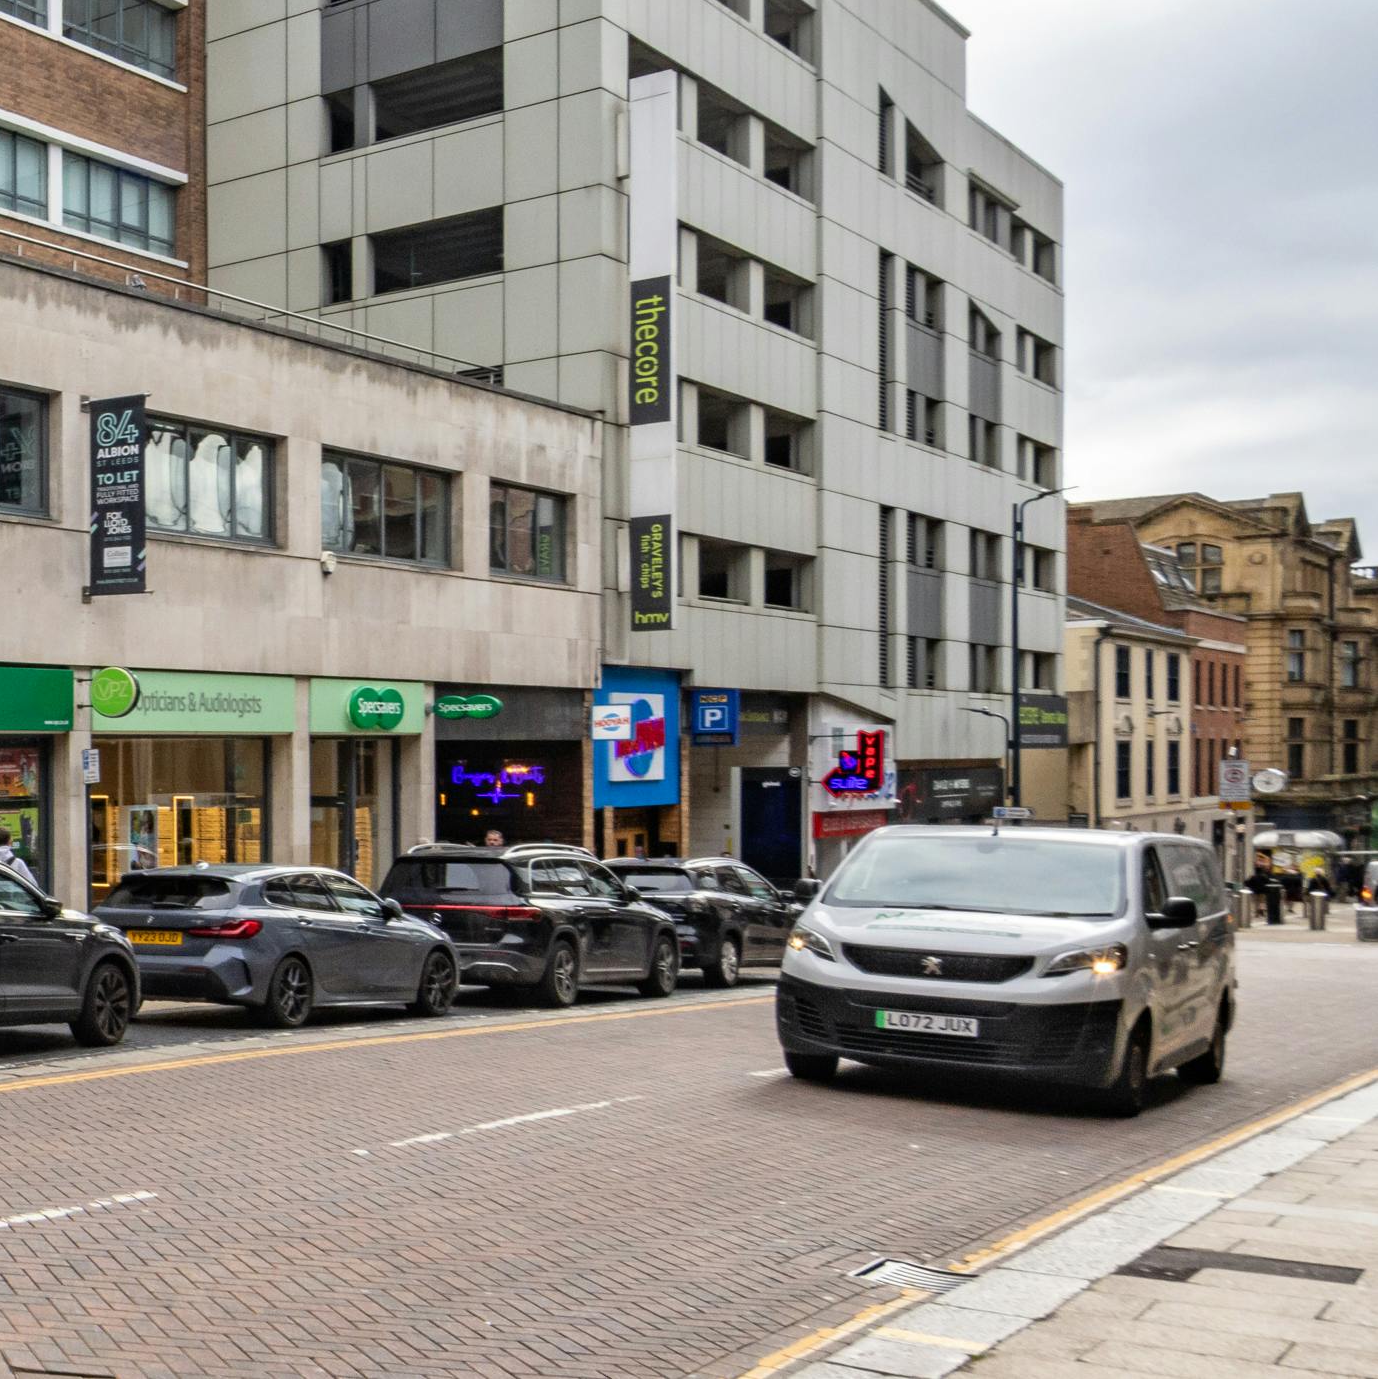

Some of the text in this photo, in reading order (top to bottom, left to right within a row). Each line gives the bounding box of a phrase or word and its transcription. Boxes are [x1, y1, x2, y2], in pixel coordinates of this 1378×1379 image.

[635, 294, 666, 405] thecore
[97, 410, 139, 447] 84
[97, 444, 140, 459] ALBION
[97, 456, 139, 467] ST LEEDS
[97, 470, 139, 485] TO LET
[96, 495, 139, 505] WORKSPACE
[106, 525, 132, 535] JONES
[651, 524, 663, 598] GRAVELEY'S
[635, 610, 670, 624] hmv
[98, 681, 128, 698] VPZ
[188, 692, 197, 712] &
[199, 692, 262, 717] Audiologists
[357, 697, 401, 717] Specsavers
[438, 701, 493, 712] Specsavers
[704, 708, 722, 728] P
[939, 1018, 973, 1033] JUX
